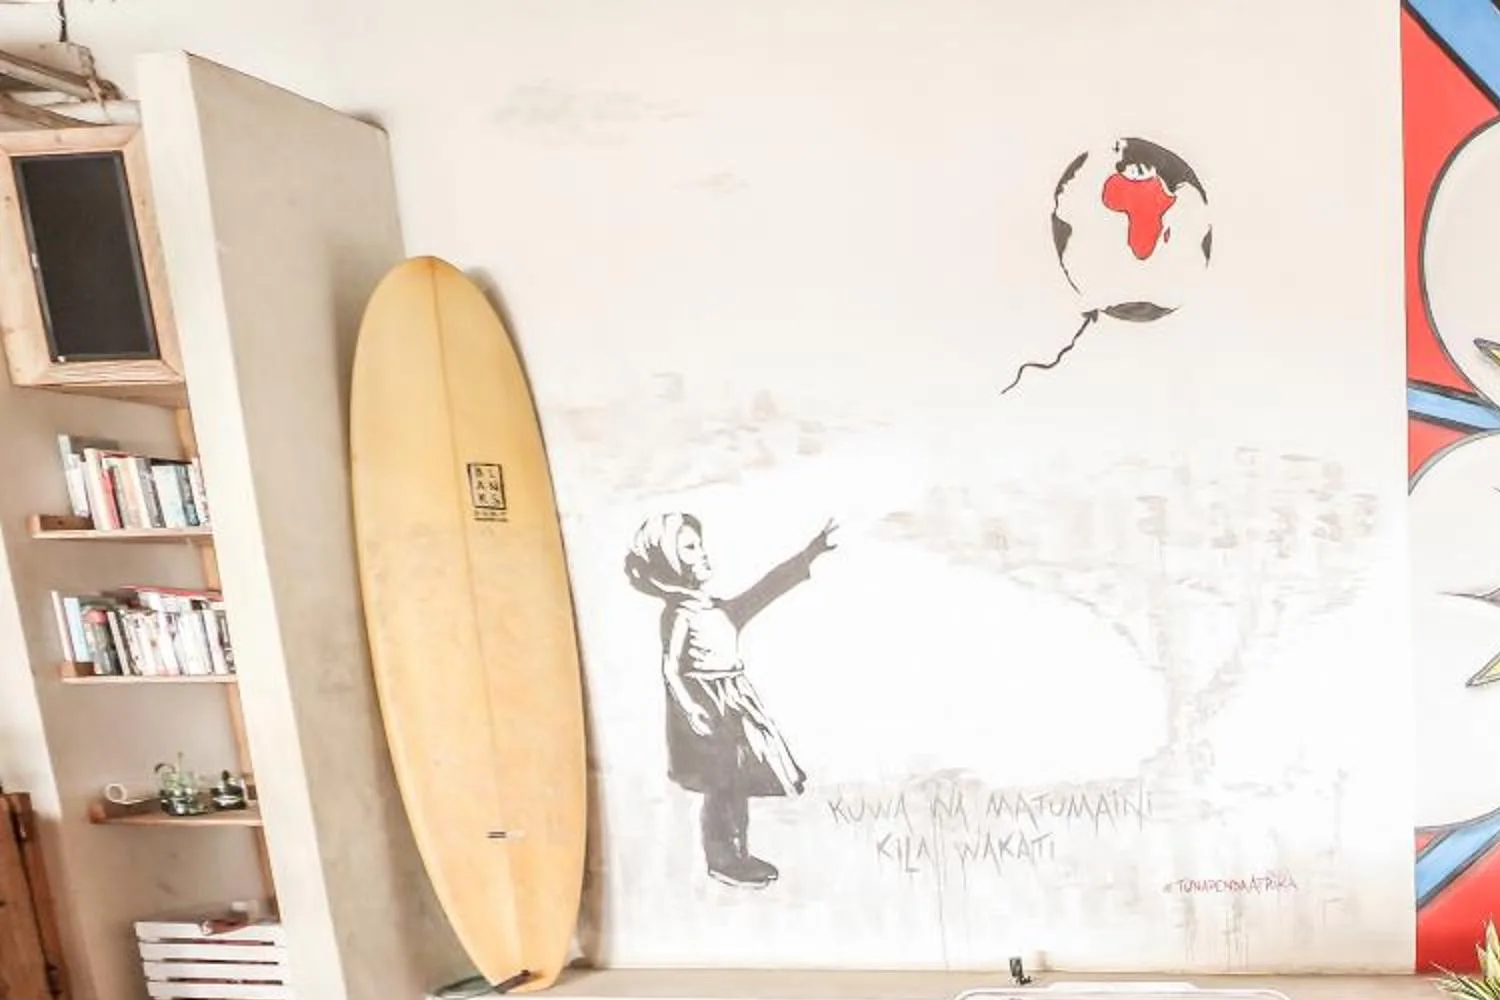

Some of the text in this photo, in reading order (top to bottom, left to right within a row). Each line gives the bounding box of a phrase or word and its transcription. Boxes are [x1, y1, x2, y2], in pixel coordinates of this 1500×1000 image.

[827, 791, 913, 836] KUWA
[986, 784, 1153, 835] MATUMAINI
[876, 830, 1055, 875] KILA WAKATI
